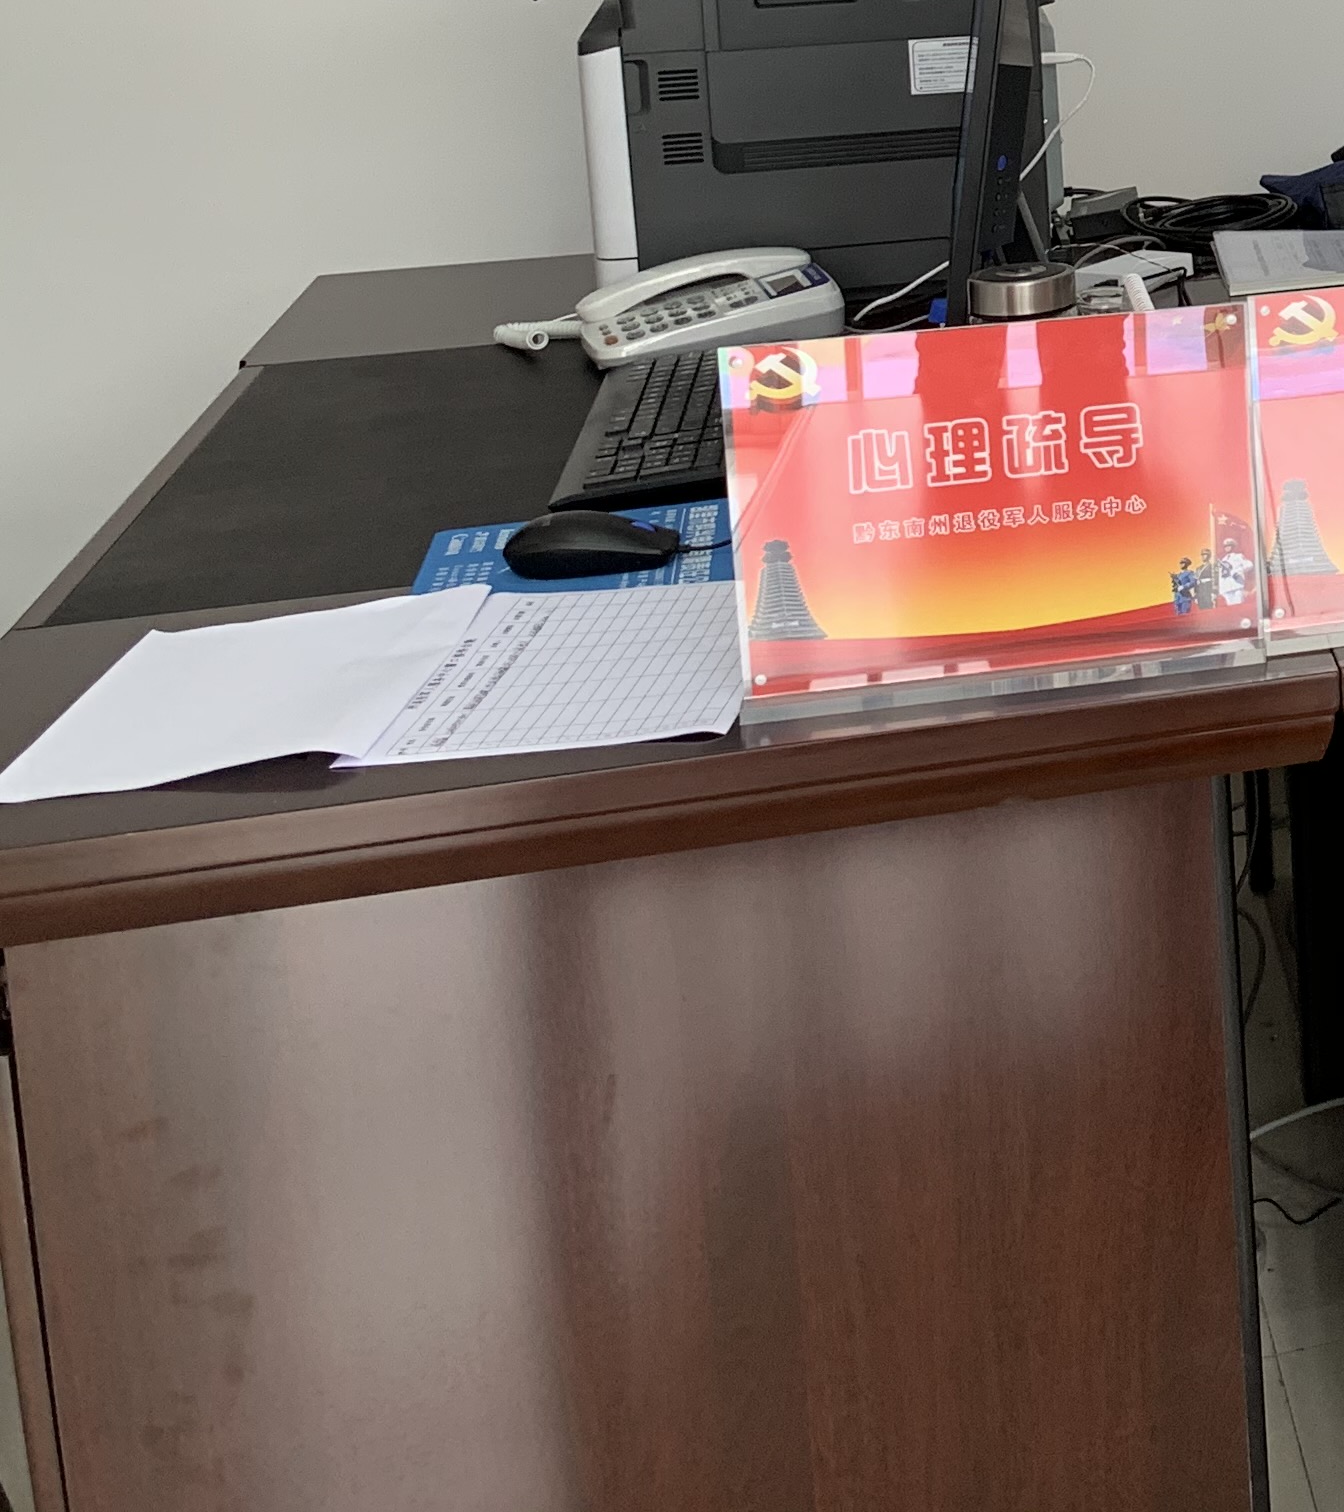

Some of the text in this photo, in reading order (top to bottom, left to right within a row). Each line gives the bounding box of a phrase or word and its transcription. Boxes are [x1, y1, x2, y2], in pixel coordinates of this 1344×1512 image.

[848, 402, 1143, 494] 心理疏导
[853, 494, 1147, 544] 黔东南州退役军人服务中心
